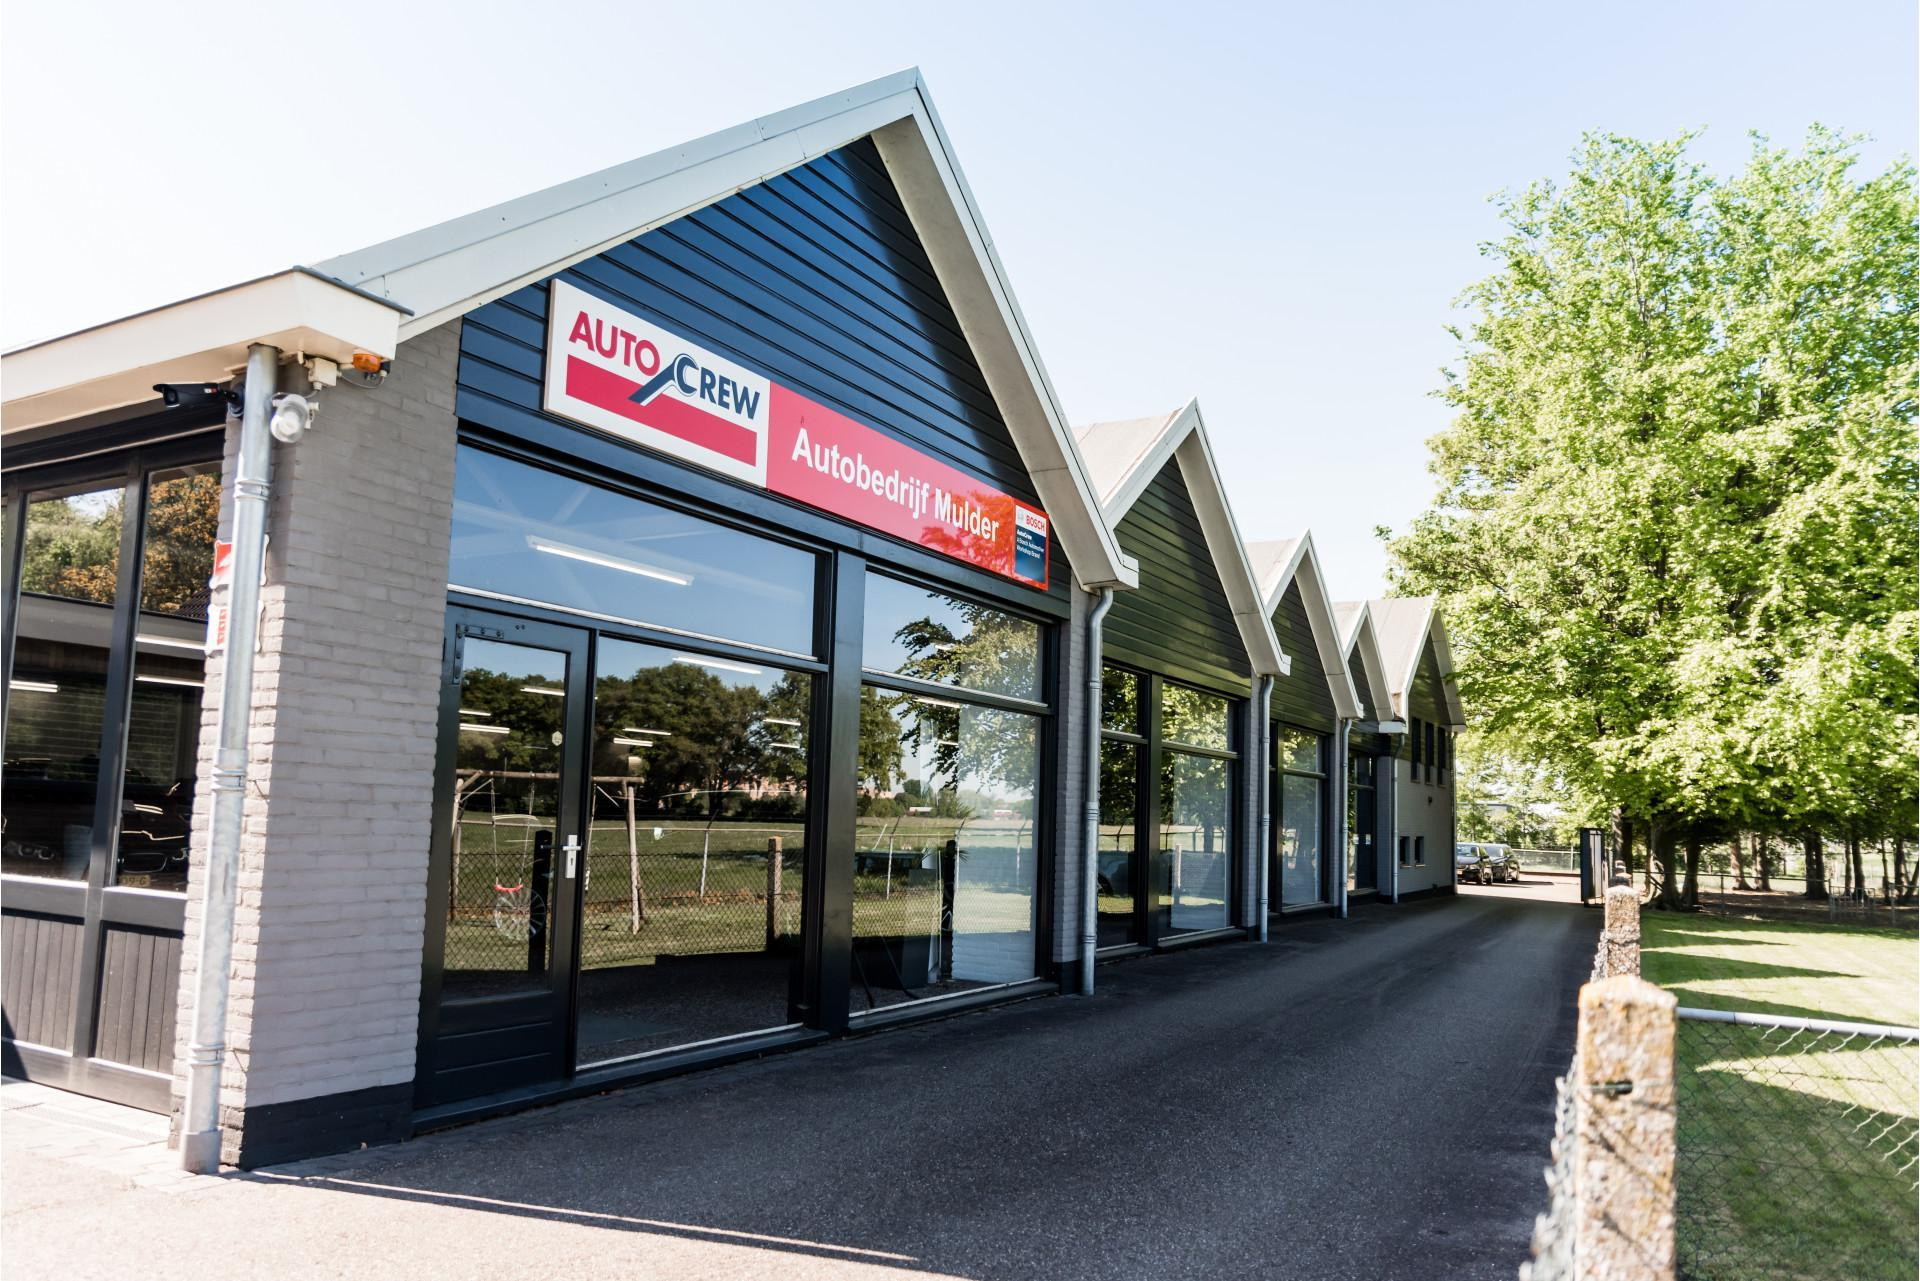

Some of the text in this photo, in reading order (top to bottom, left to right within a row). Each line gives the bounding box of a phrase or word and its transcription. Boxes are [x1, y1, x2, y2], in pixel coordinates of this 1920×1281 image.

[568, 310, 760, 420] AUTO CREW
[791, 427, 1000, 542] Autobedrijf Mulder
[1026, 514, 1044, 531] BOSCH
